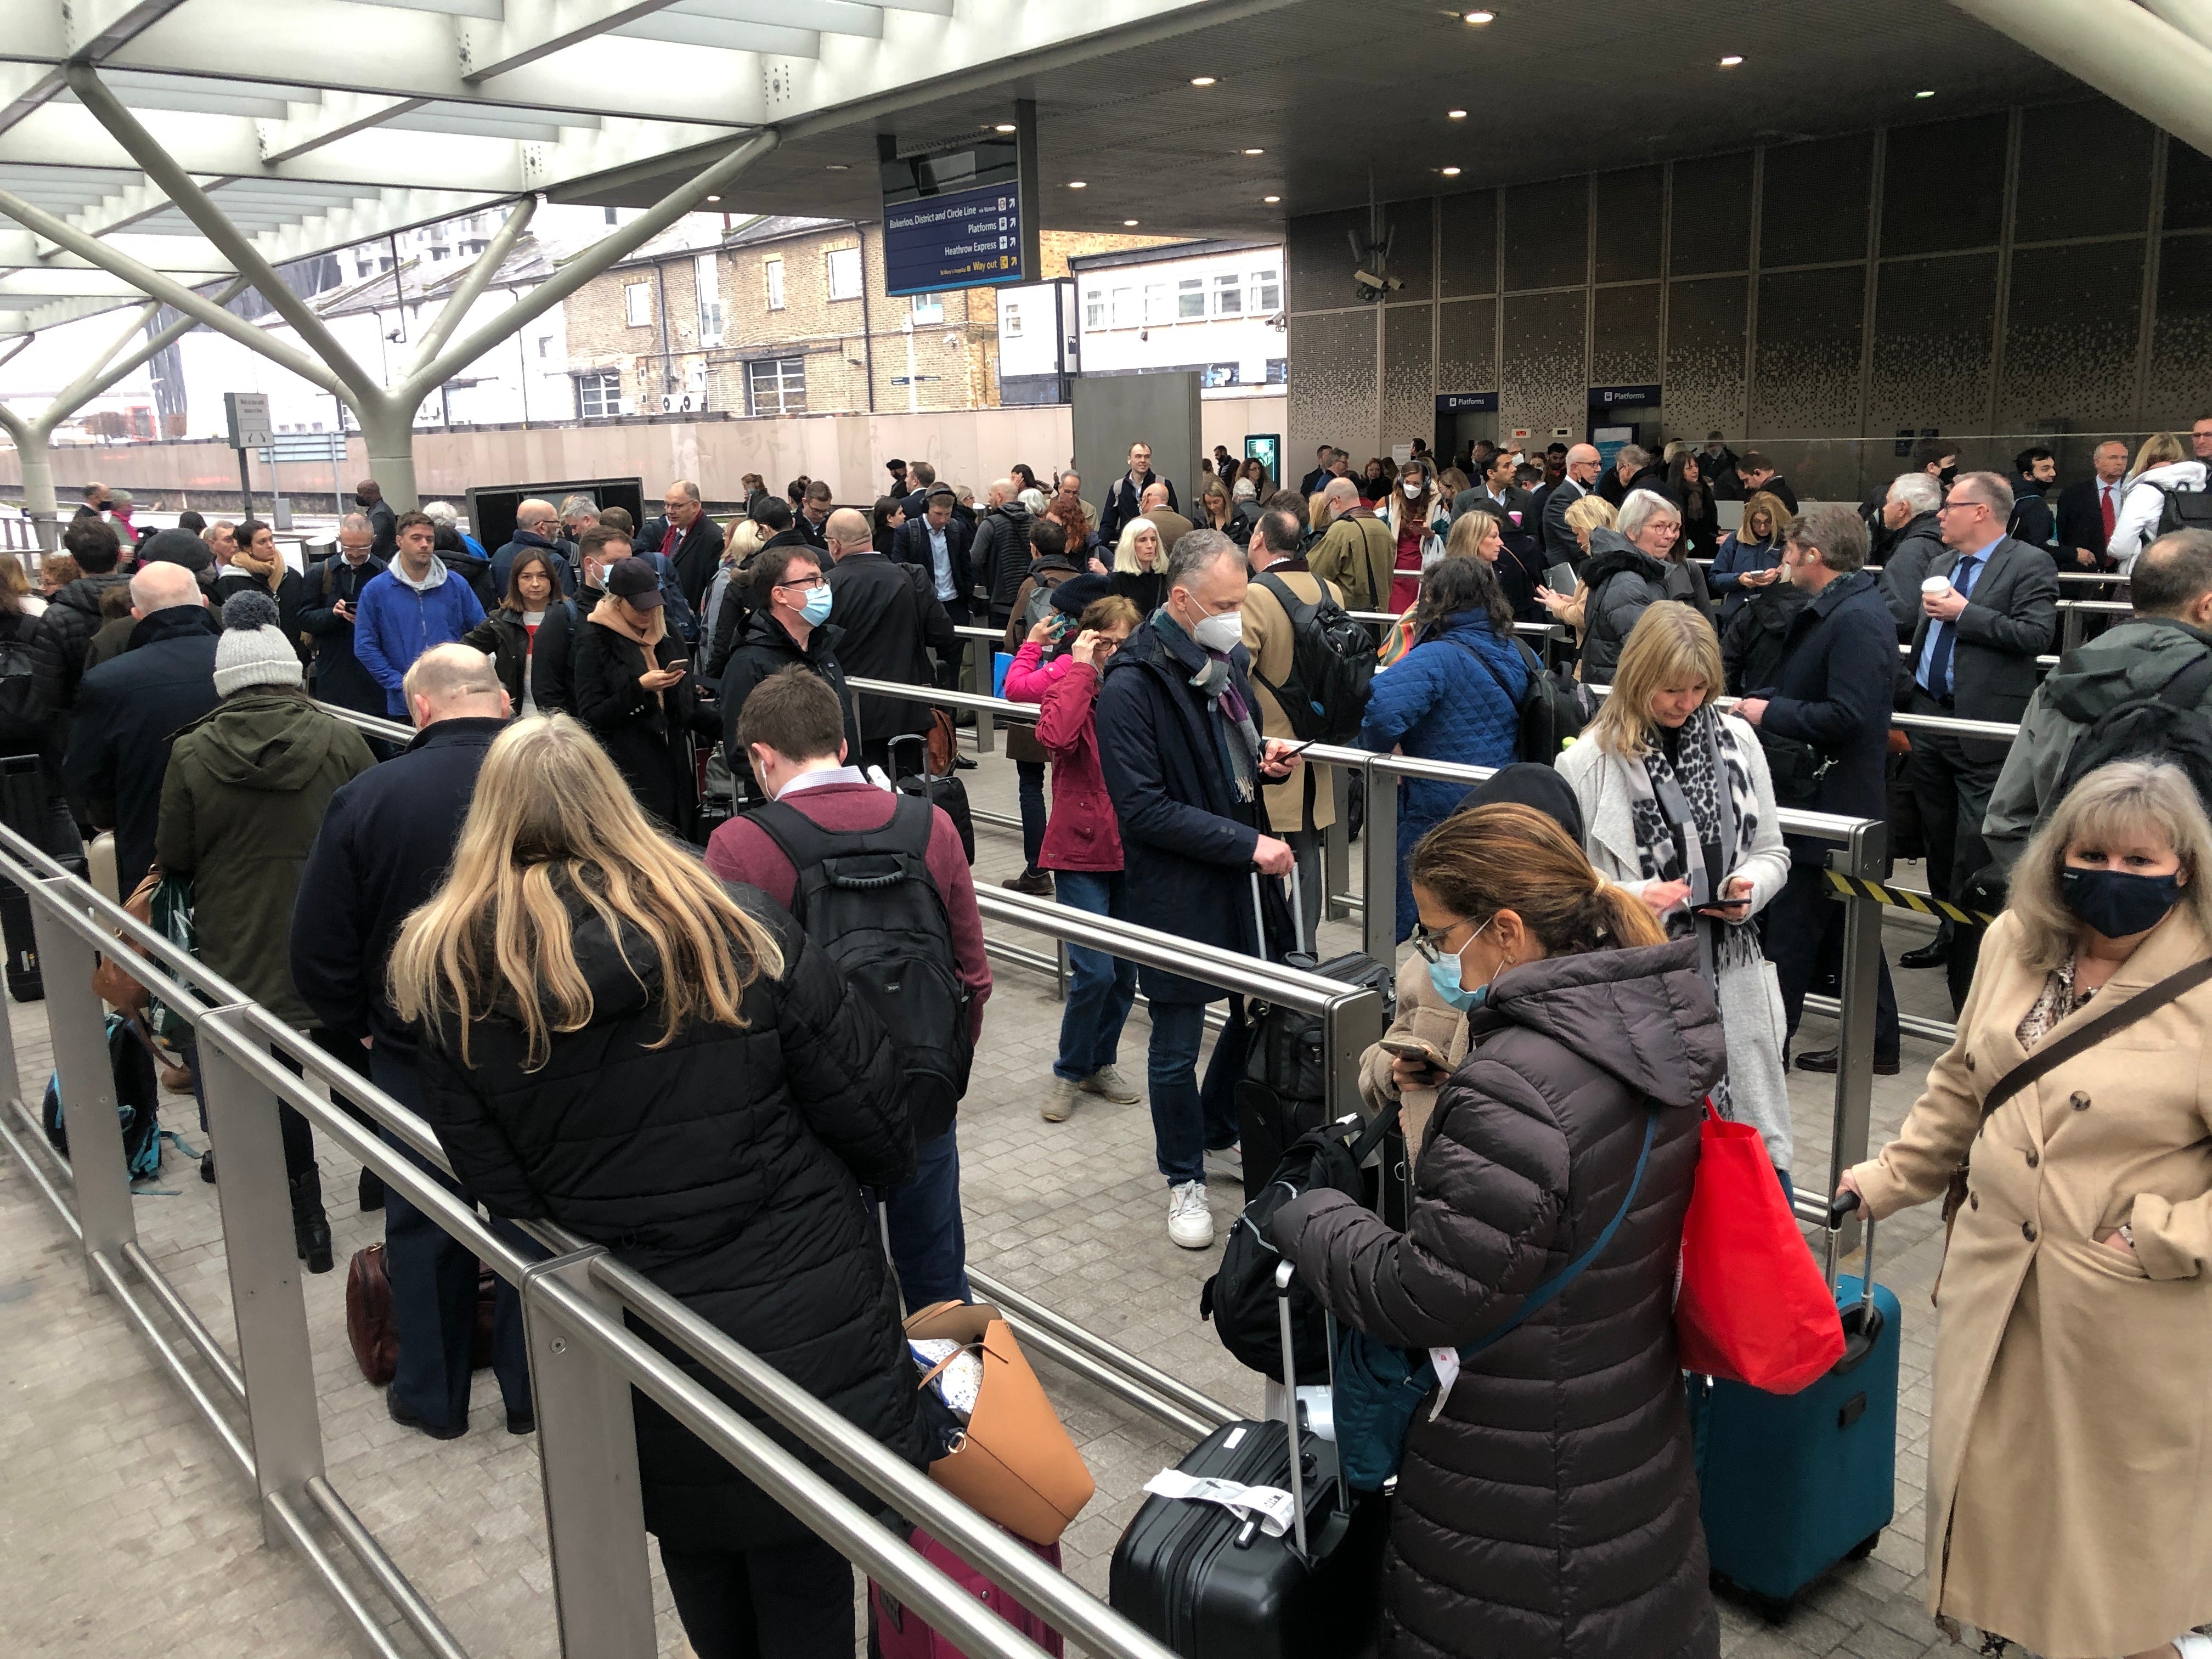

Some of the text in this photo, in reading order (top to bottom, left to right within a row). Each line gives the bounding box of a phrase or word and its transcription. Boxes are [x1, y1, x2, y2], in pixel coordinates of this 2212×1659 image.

[889, 218, 913, 229] Bakerloo,
[915, 213, 934, 224] District
[935, 210, 946, 221] and
[947, 207, 963, 218] Circle
[963, 206, 977, 216] Line
[968, 222, 997, 234] Platforms
[945, 241, 997, 256] Heathrow Express
[973, 261, 986, 272] Way
[986, 259, 997, 269] out
